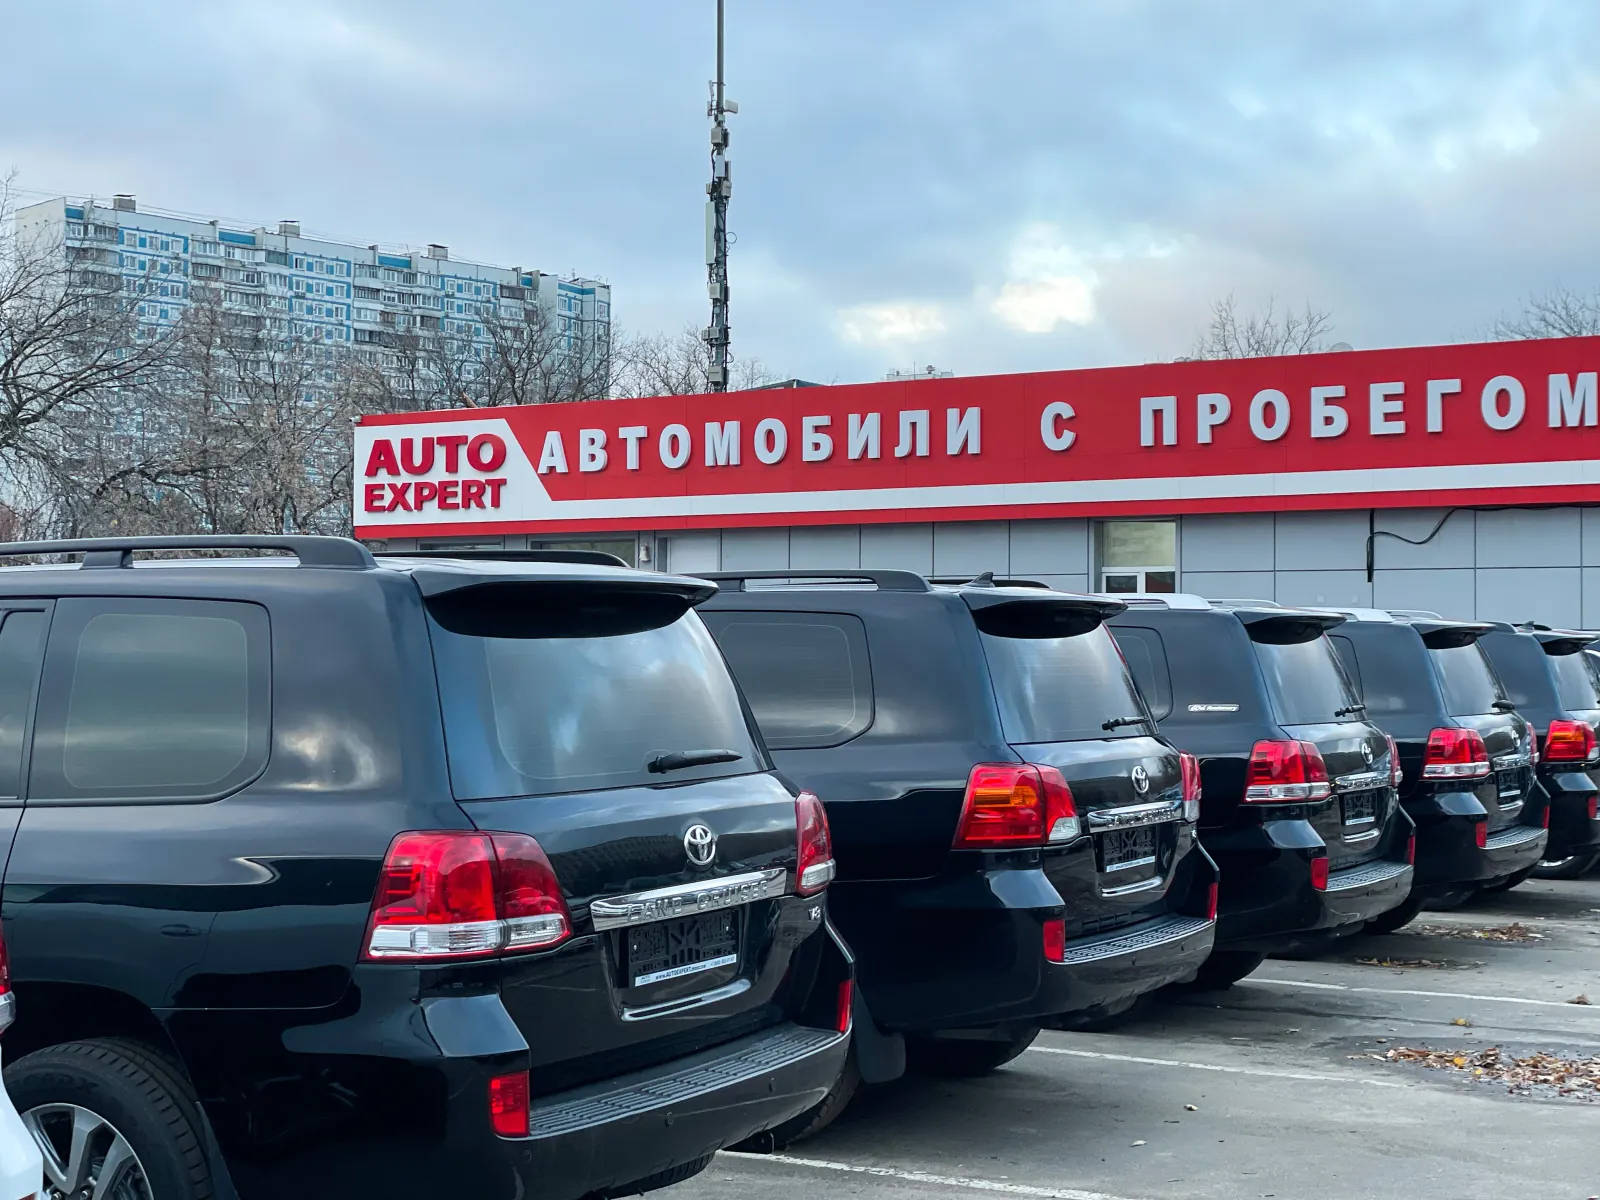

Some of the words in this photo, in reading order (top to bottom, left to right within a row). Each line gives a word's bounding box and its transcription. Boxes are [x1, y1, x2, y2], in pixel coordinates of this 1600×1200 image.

[537, 407, 982, 474] АВТОМОБИЛИ
[1040, 401, 1077, 451] С
[1140, 372, 1598, 446] ПРОБЕГОМ
[365, 433, 507, 477] AUTO
[364, 478, 507, 512] EXPERT
[696, 880, 768, 911] CRUISER
